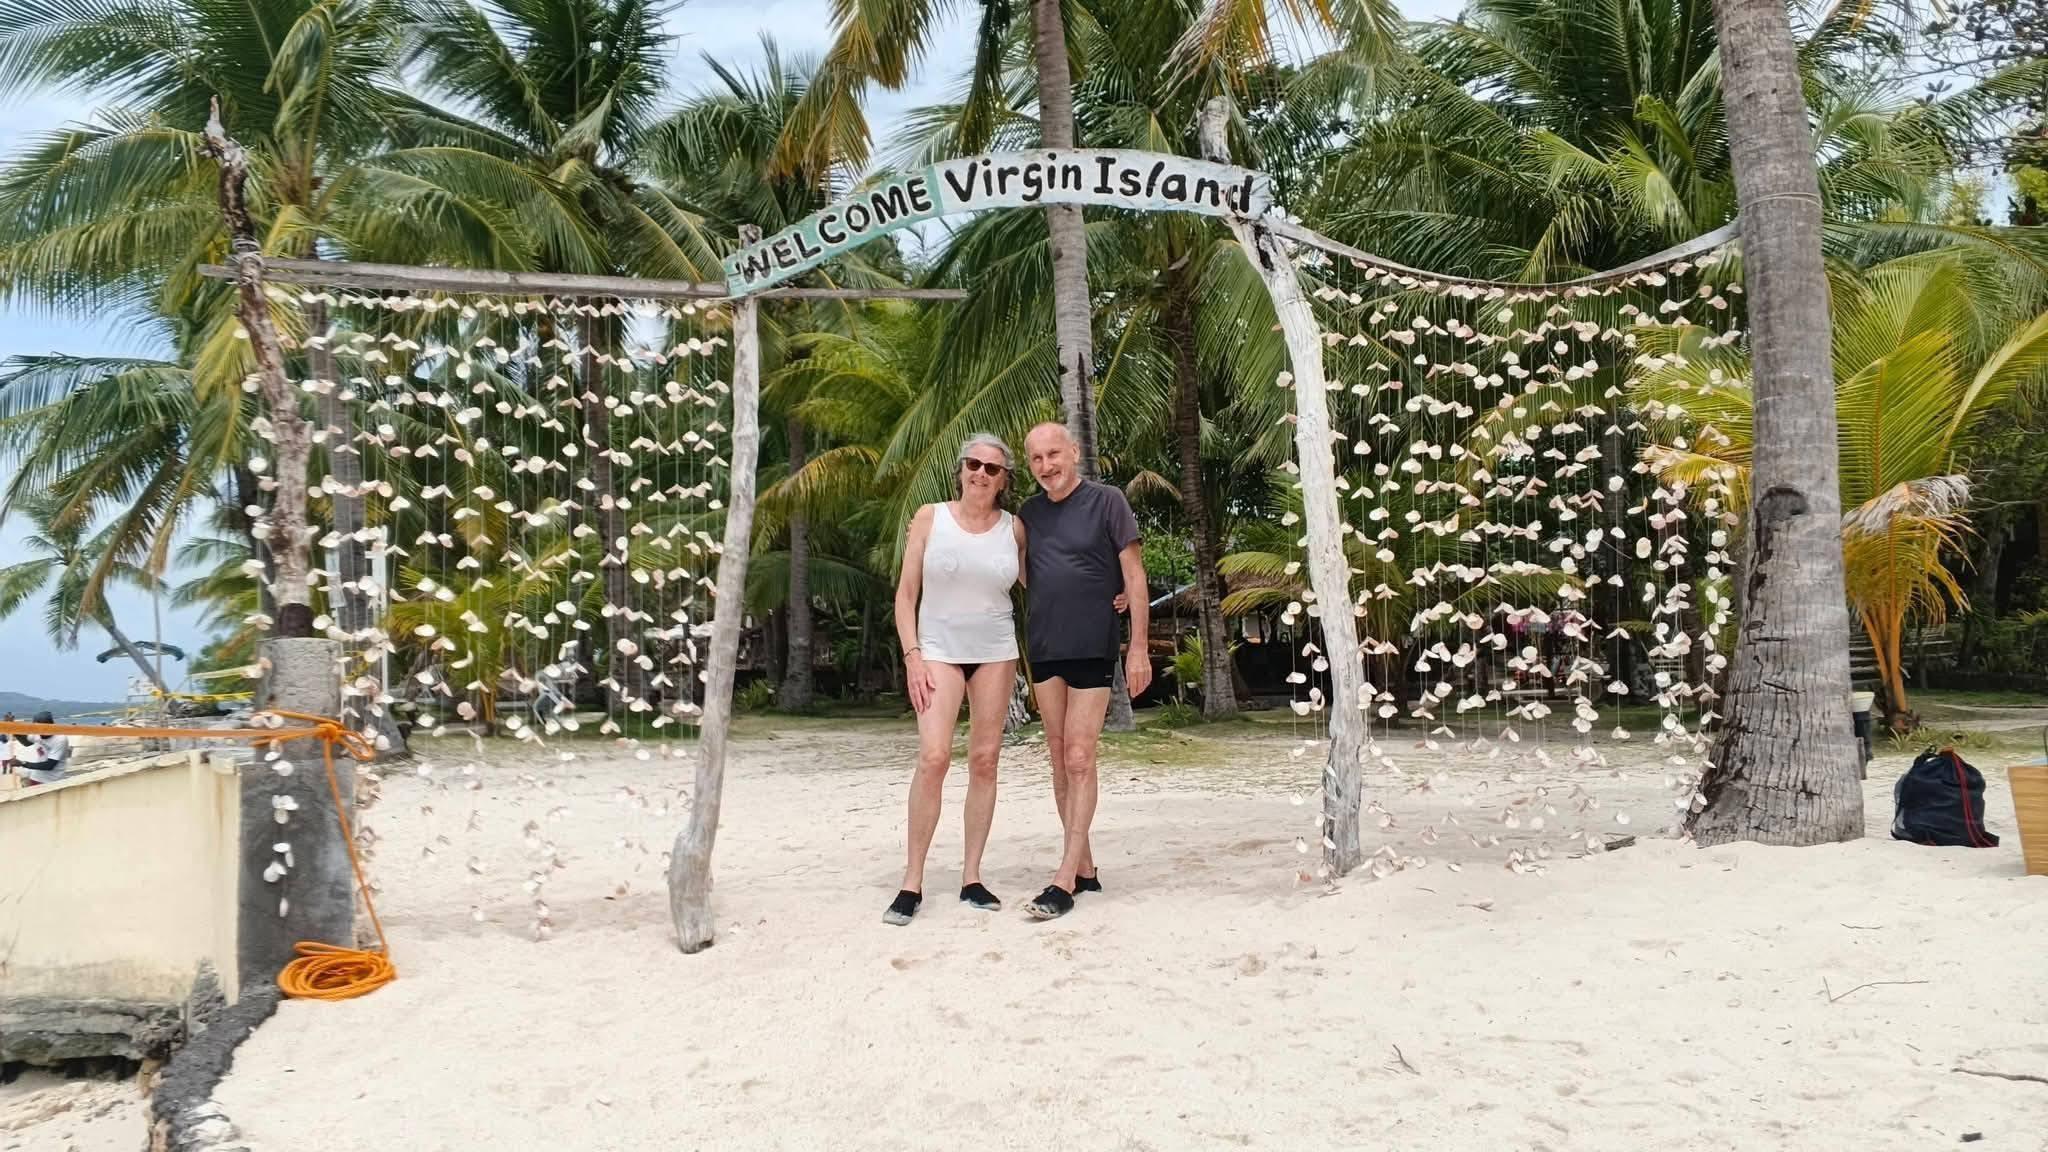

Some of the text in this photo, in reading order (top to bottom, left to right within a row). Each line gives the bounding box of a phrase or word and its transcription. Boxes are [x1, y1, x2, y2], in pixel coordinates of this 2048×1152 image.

[735, 152, 1254, 285] WELCOME Virgin Island
